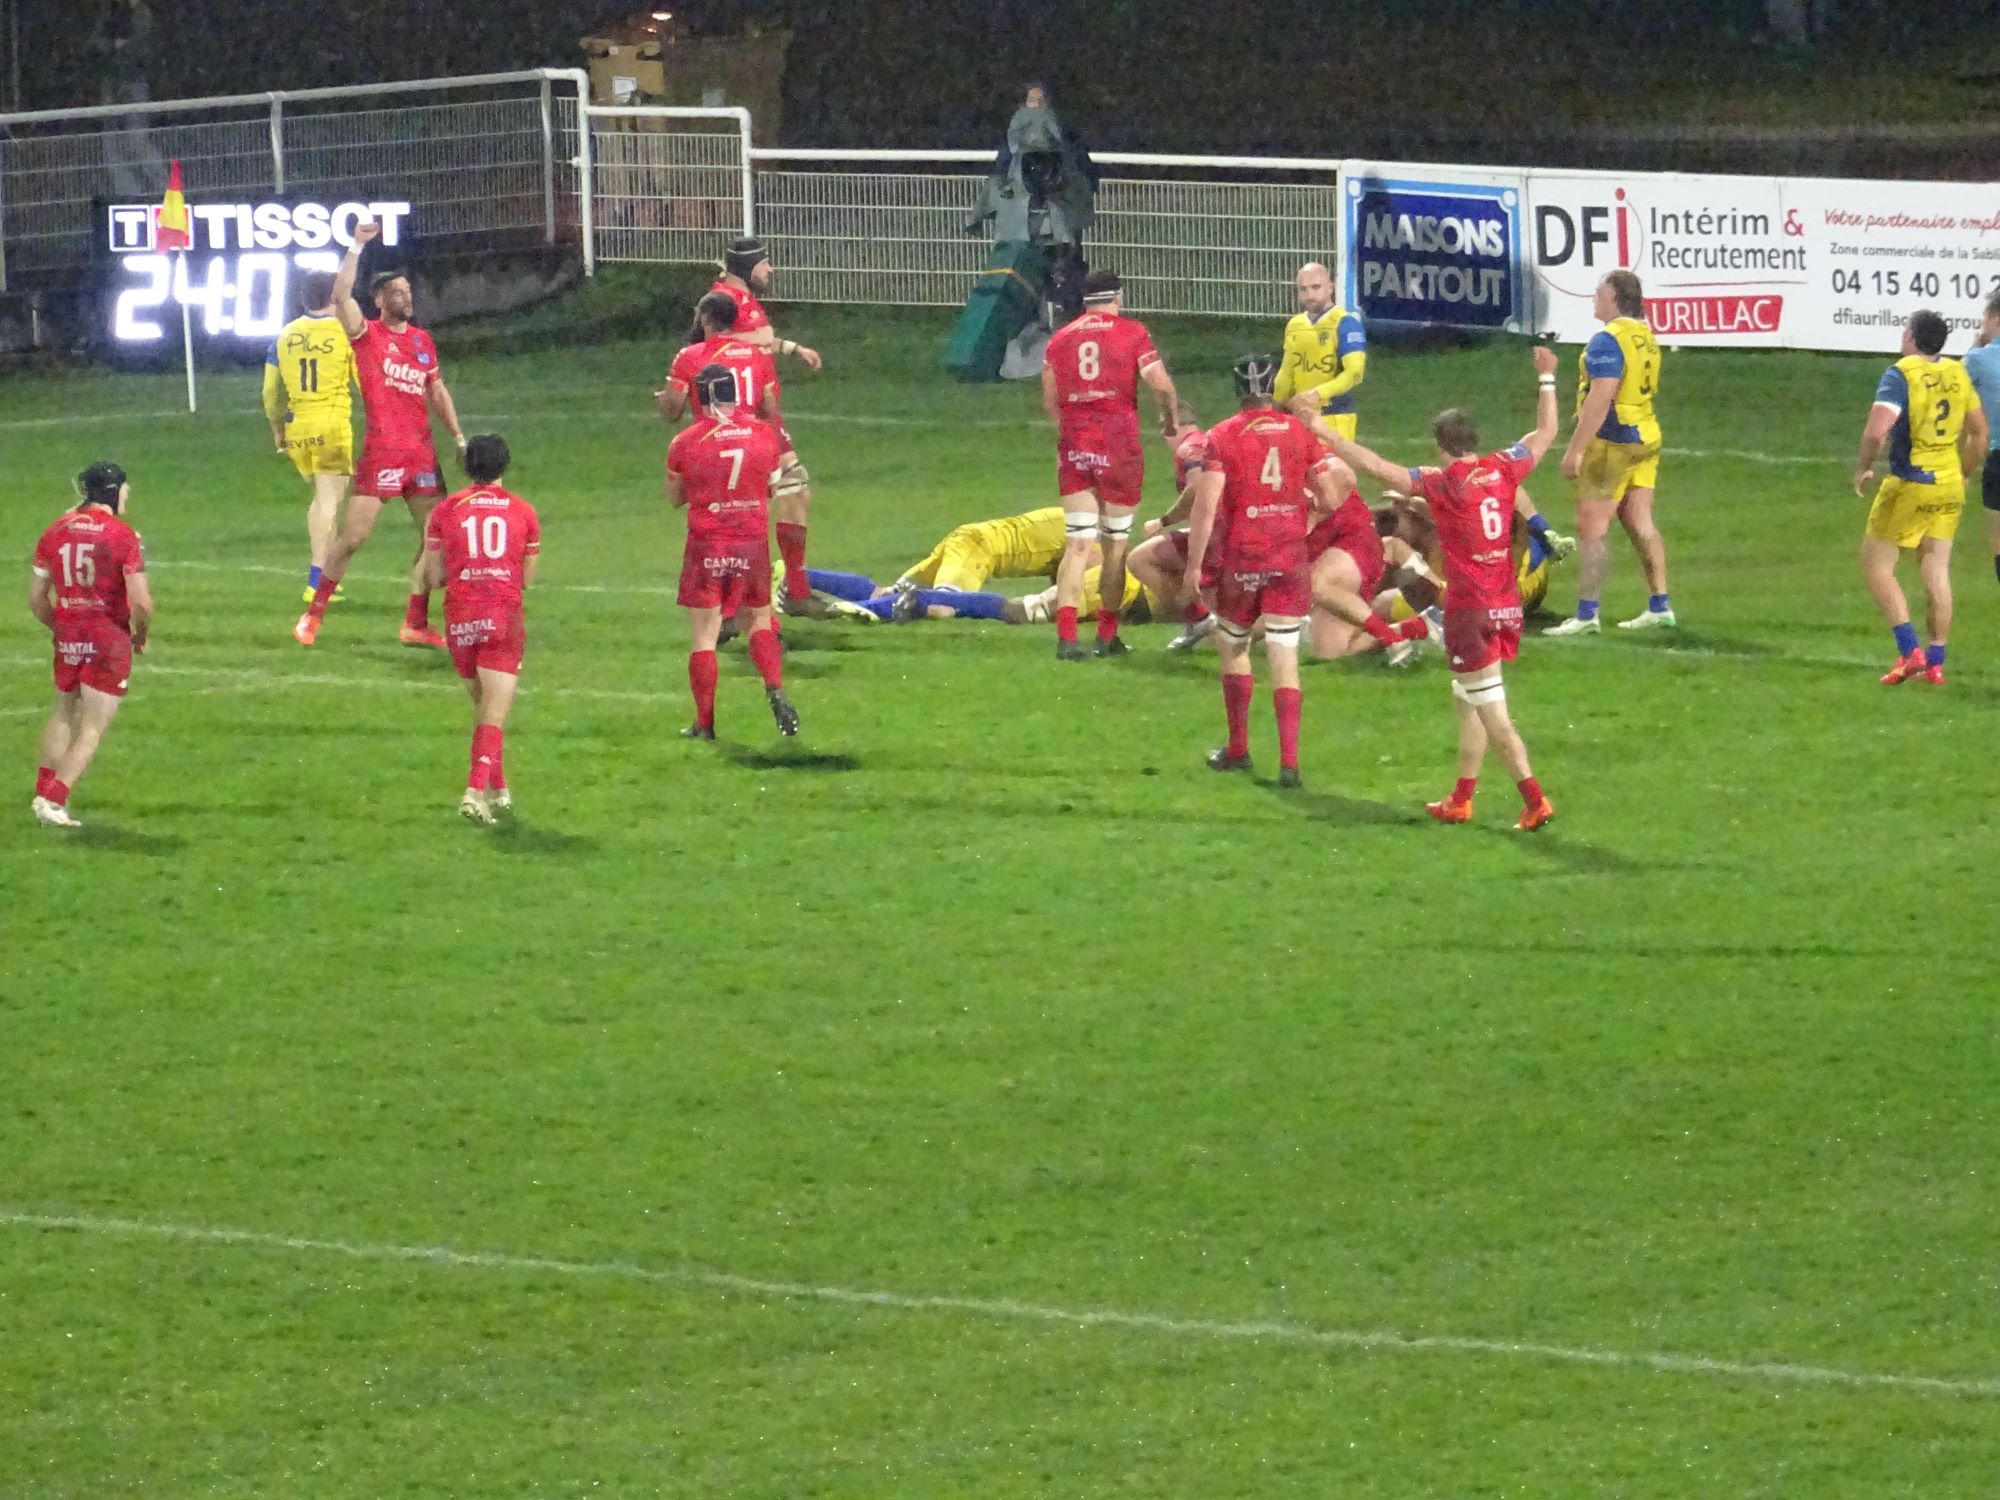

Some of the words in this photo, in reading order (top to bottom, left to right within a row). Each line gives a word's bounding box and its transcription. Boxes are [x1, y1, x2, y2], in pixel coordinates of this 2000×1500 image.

[194, 202, 411, 249] TISSOT
[1364, 212, 1504, 258] MAISONS
[1650, 206, 1769, 235] Intérim
[1784, 209, 1805, 237] &
[1825, 208, 1864, 226] Votre
[1866, 210, 1957, 232] partenaire
[1651, 240, 1808, 271] Recrutement
[1830, 242, 1859, 255] Zone
[1862, 245, 1936, 259] commerciale
[1939, 246, 1955, 259] de
[1957, 246, 1969, 260] la
[1363, 260, 1505, 306] PARTOUT
[1832, 269, 1862, 294] 04
[1872, 271, 1900, 296] 15
[1909, 272, 1940, 297] 40
[1950, 273, 1980, 299] 10
[286, 332, 335, 354] Plus
[299, 358, 317, 392] 11
[1079, 341, 1100, 380] 8
[714, 427, 752, 437] cantal
[1934, 399, 1950, 436] 2
[284, 436, 325, 450] EVERS
[719, 449, 744, 490] 7
[1260, 447, 1283, 491] 4
[470, 498, 510, 506] cantal
[1480, 497, 1503, 540] 6
[461, 515, 507, 559] 10
[58, 543, 97, 587] 15
[704, 557, 750, 569] CANTAL
[450, 619, 496, 635] CANTAL
